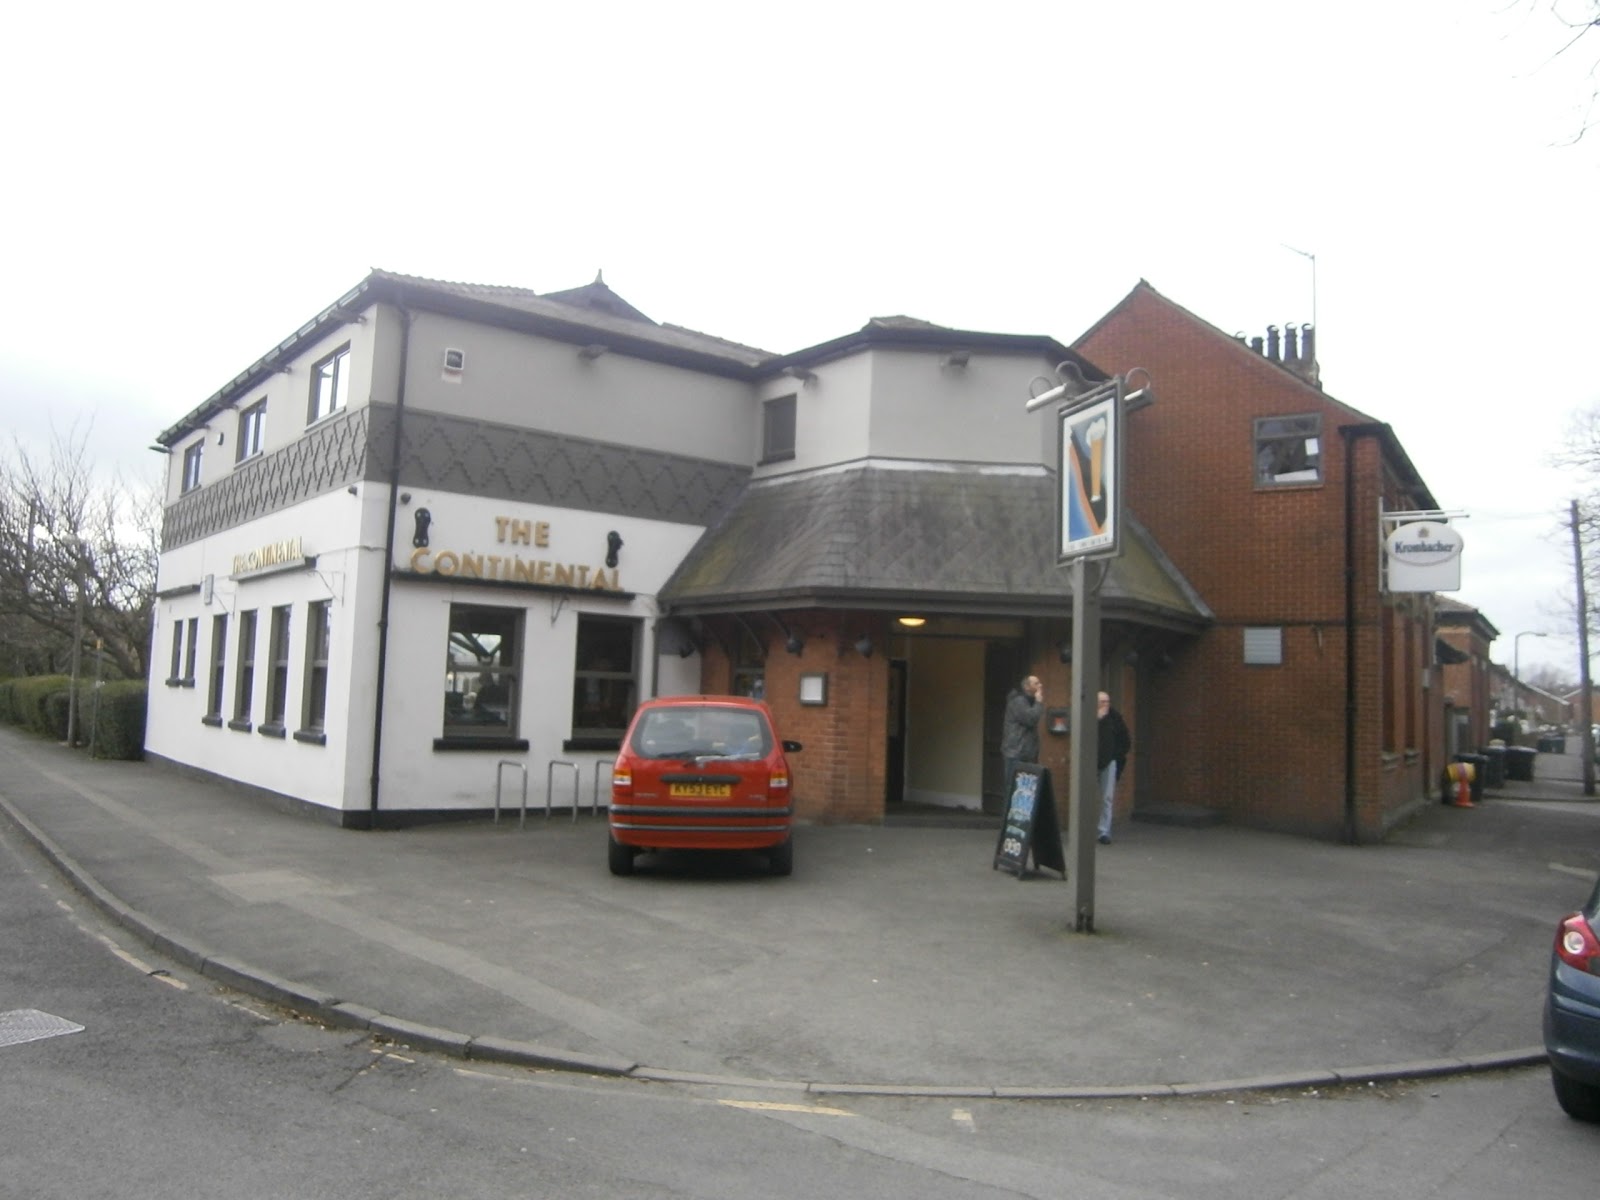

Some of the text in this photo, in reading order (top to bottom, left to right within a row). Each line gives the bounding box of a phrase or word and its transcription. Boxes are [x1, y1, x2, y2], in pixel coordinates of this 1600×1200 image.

[496, 516, 550, 547] THE
[1395, 540, 1454, 554] Krombacher
[410, 547, 625, 592] CONTINENTAL
